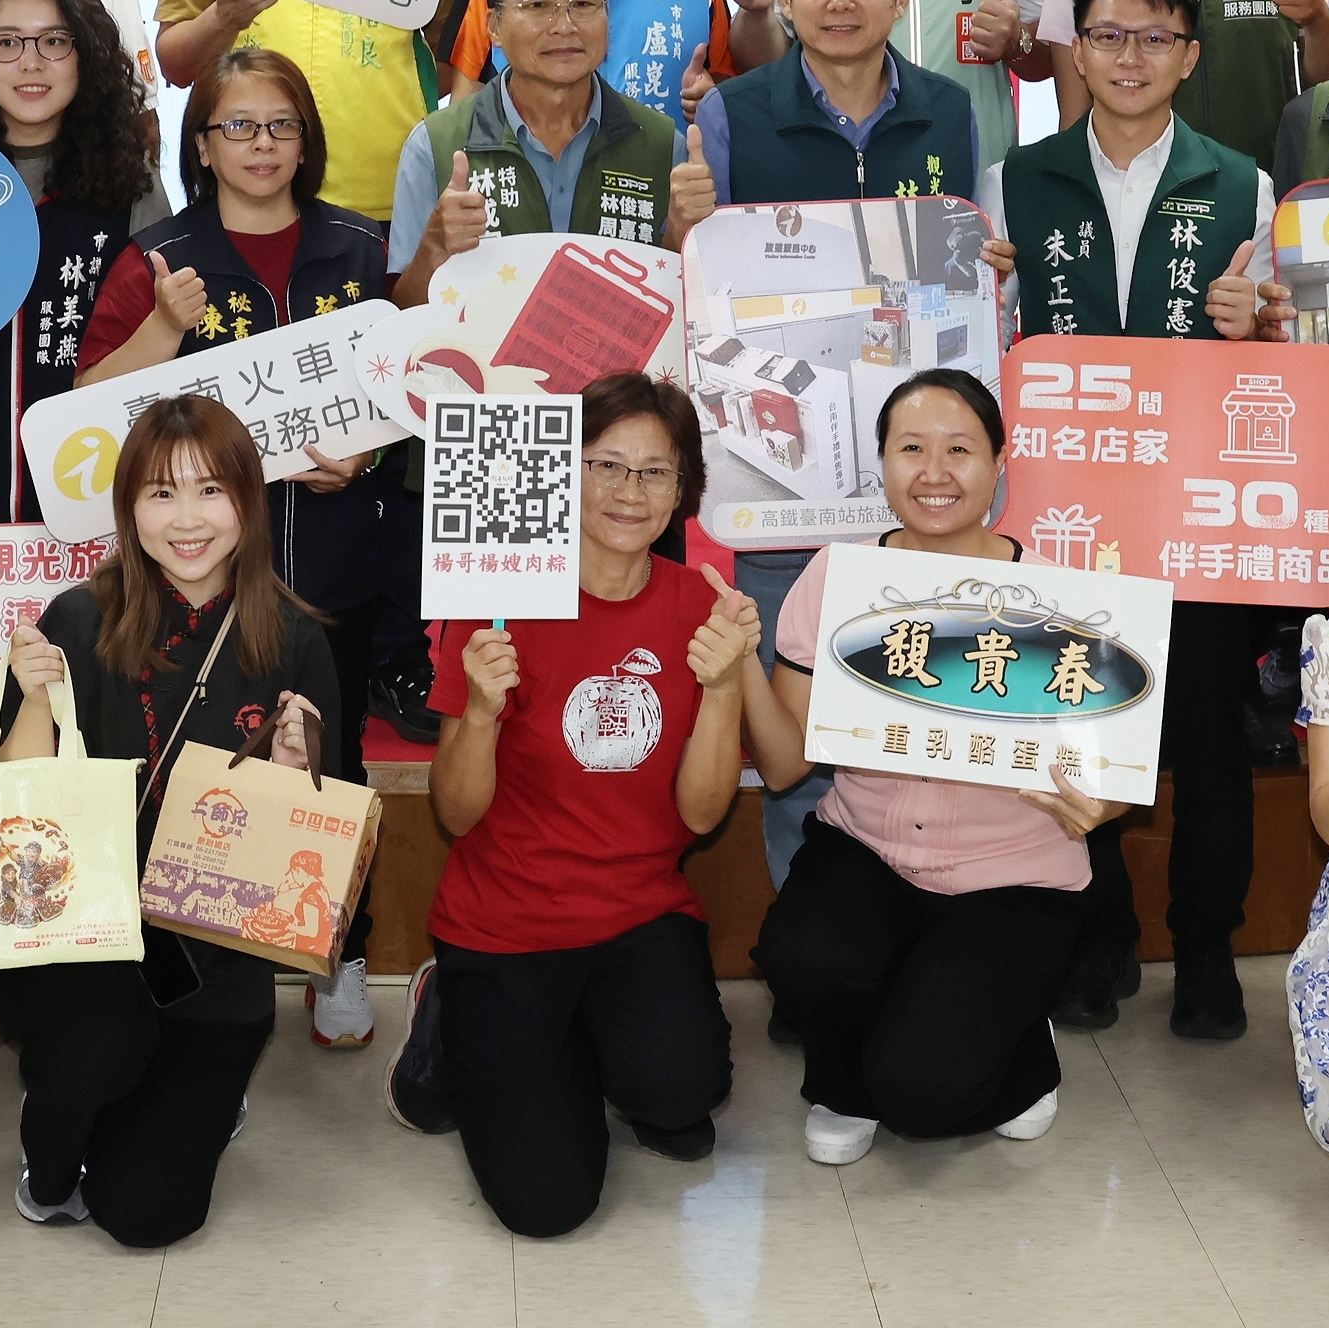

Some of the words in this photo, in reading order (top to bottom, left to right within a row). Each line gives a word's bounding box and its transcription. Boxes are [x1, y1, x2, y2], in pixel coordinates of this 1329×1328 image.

[1224, 0, 1279, 17] 服務團隊
[339, 10, 356, 60] 務團隊
[669, 4, 685, 62] 市議員
[642, 20, 670, 117] 盧崑
[497, 165, 520, 209] 特助
[617, 177, 650, 192] DPP
[600, 193, 655, 220] 林俊憲
[1174, 201, 1211, 215] DPP
[1077, 220, 1096, 260] 議員
[342, 280, 362, 302] 市
[1043, 228, 1078, 336] 朱正軒
[1165, 218, 1204, 333] 林俊憲
[54, 254, 88, 368] 林美燕
[36, 300, 55, 365] 服務團隊
[1249, 378, 1271, 386] SHOP
[1011, 423, 1170, 465] 知名店家
[761, 504, 903, 529] 高鐵臺南站旅遊
[431, 550, 568, 574] 楊哥楊嫂肉粽
[881, 620, 1107, 706] 馥貴春
[882, 722, 1085, 778] 重乳酪蛋糕
[191, 799, 249, 828] 二師兄
